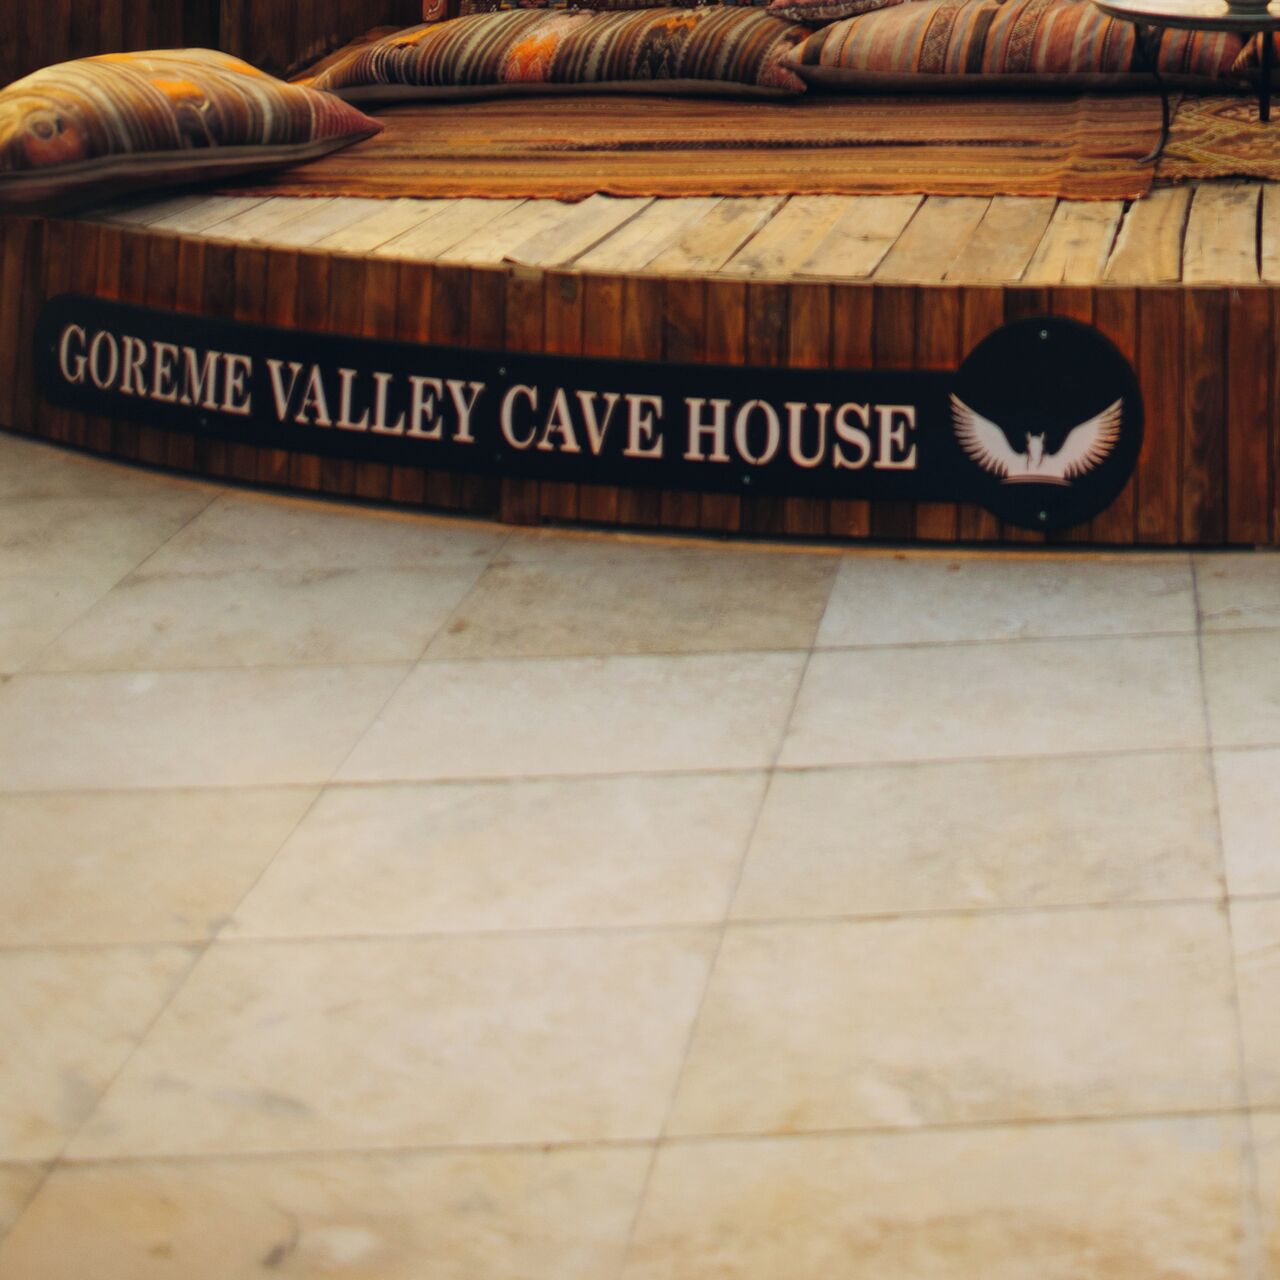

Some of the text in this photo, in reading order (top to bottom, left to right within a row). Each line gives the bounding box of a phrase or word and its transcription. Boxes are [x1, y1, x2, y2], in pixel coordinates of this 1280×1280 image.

[266, 359, 485, 442] VALLEY
[501, 384, 663, 458] CAVE
[684, 397, 917, 469] HOUSE
